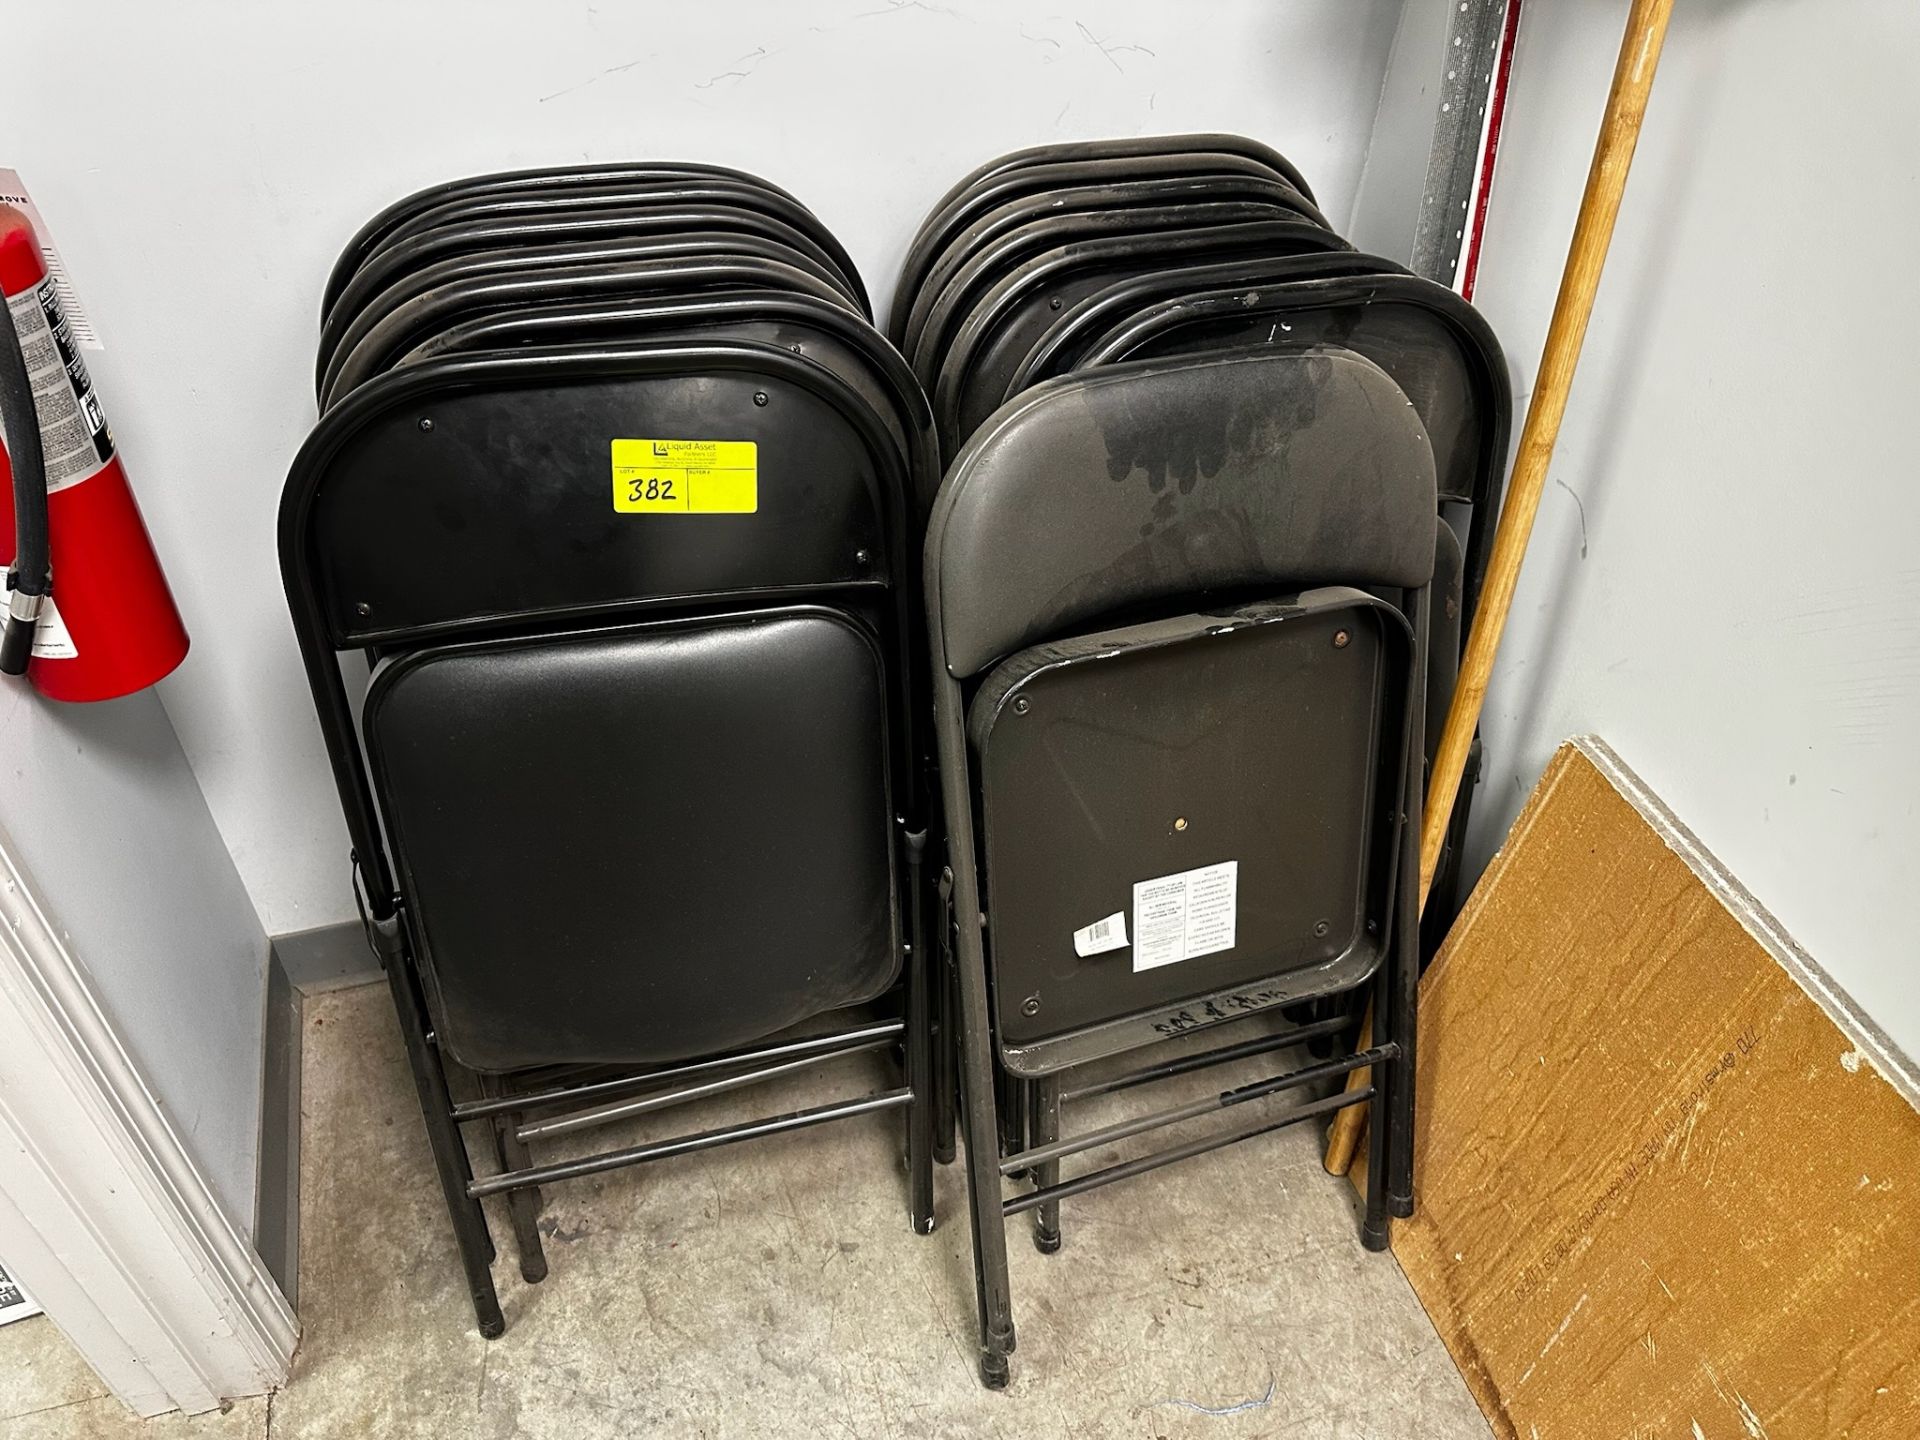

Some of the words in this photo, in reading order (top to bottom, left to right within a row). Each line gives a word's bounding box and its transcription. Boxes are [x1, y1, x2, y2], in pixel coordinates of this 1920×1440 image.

[666, 442, 692, 452] Liquid
[694, 443, 717, 451] Asset
[628, 478, 677, 502] 382
